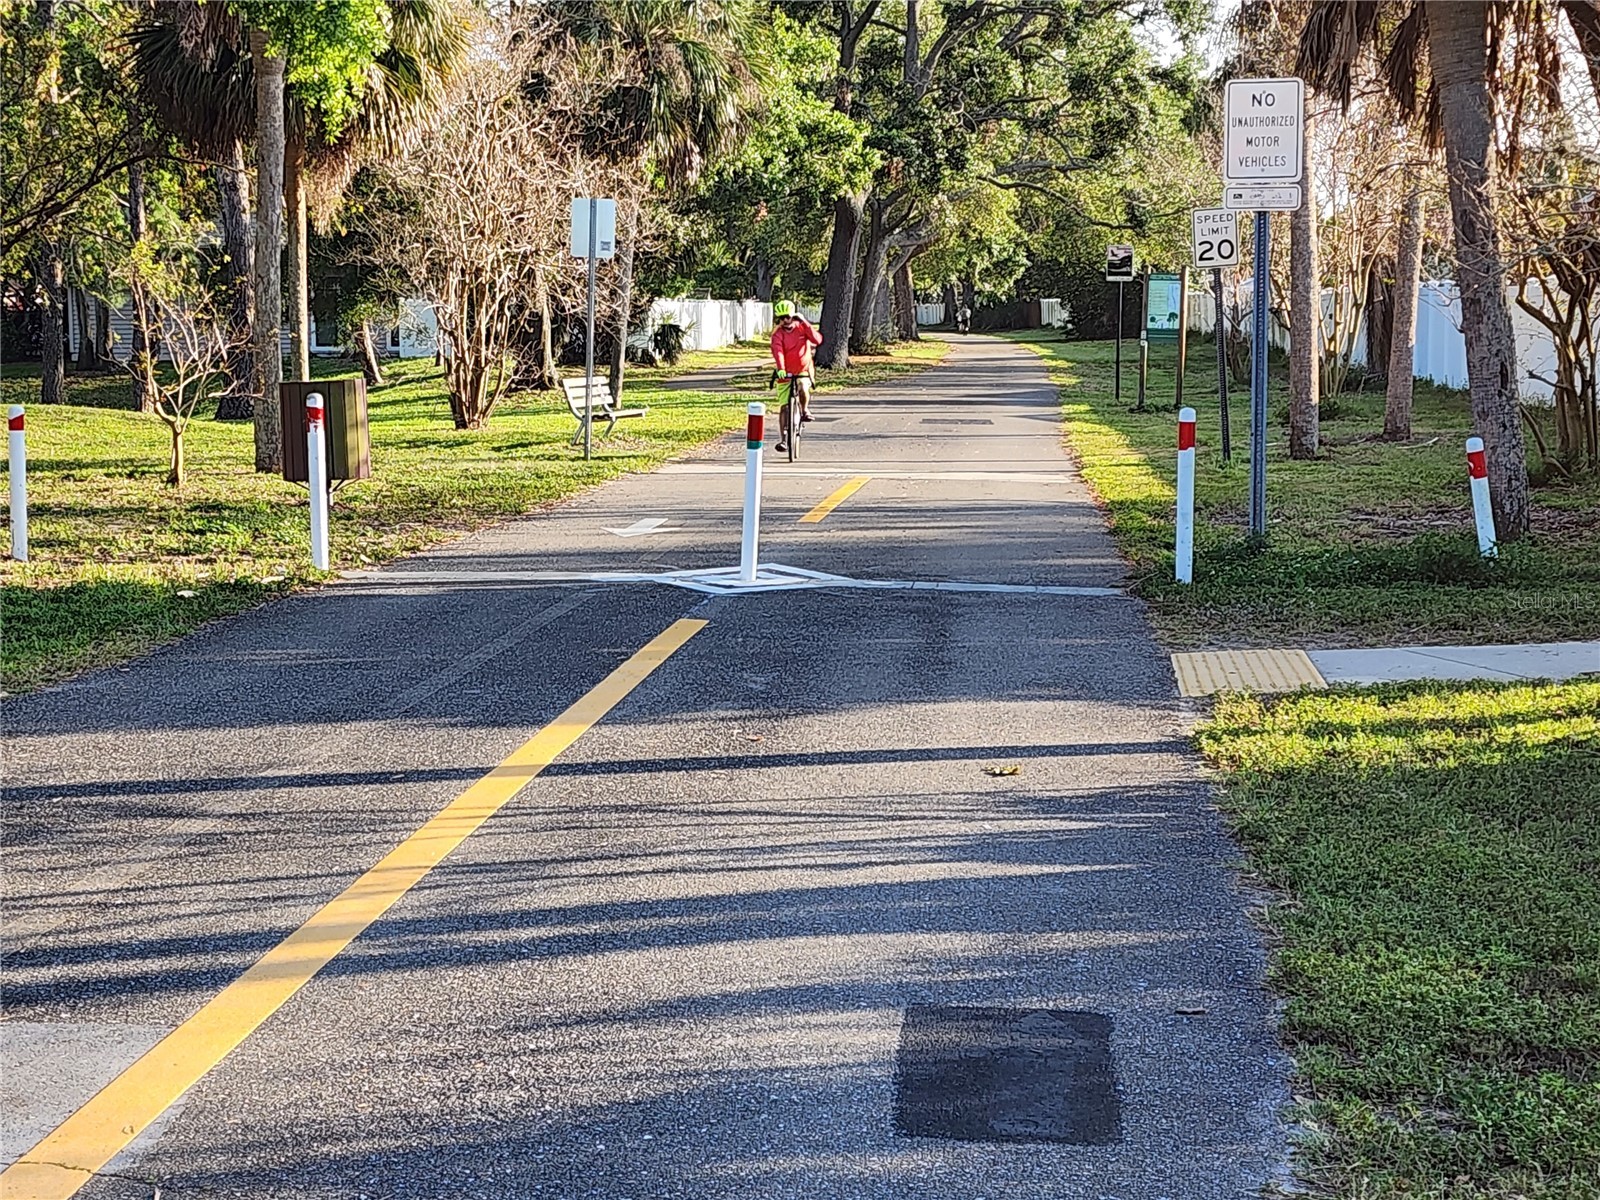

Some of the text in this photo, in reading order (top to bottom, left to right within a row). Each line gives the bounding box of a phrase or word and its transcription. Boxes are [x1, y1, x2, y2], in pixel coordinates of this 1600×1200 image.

[1251, 93, 1275, 107] NO
[1231, 115, 1295, 128] UNAUTHORIZED
[1245, 136, 1280, 147] MOTOR
[1238, 156, 1287, 168] VEHICLES
[1196, 213, 1234, 224] SPEED
[1200, 226, 1229, 237] LIMIT
[1198, 239, 1234, 262] 20
